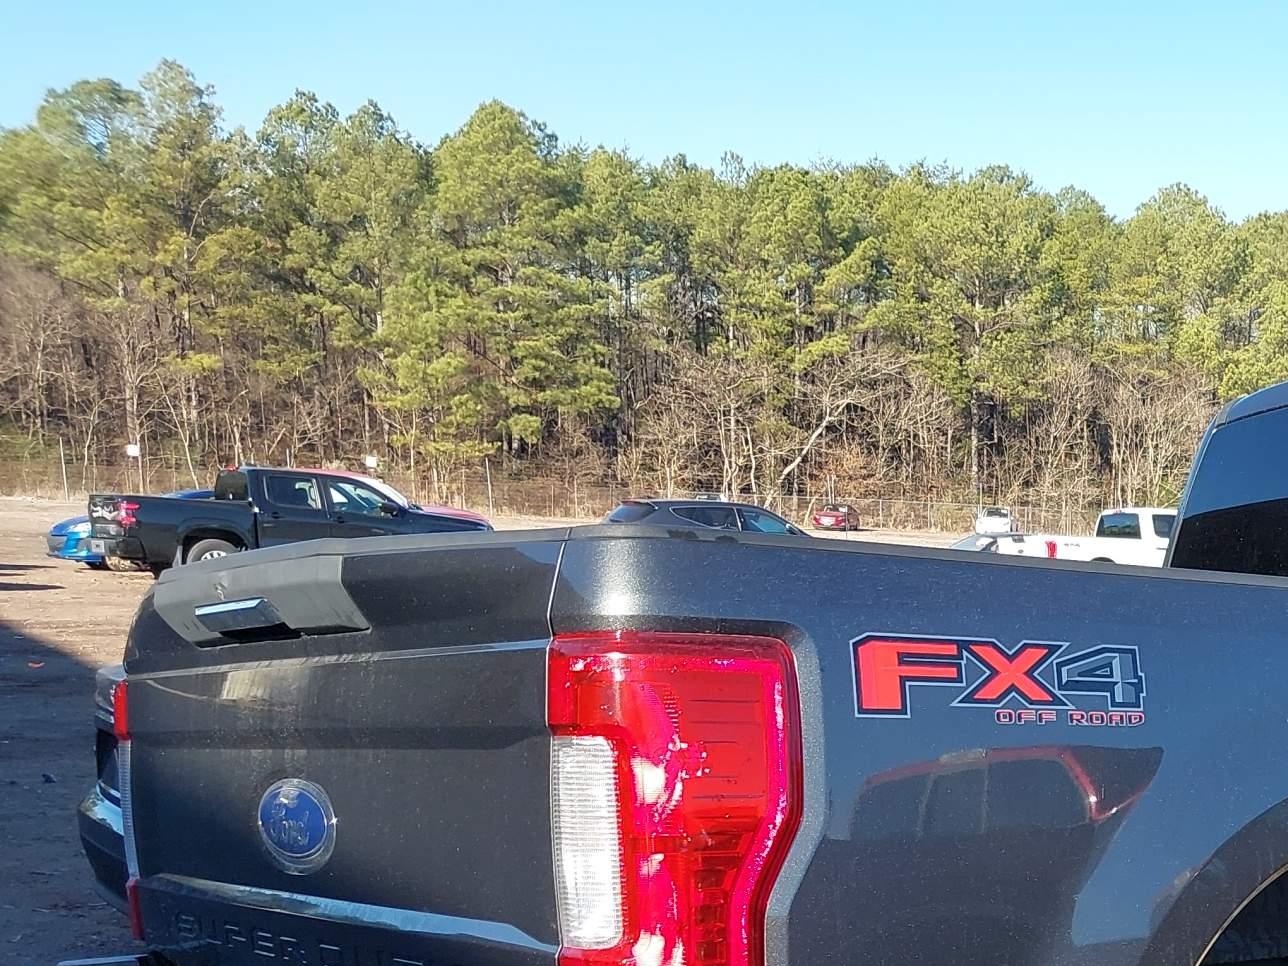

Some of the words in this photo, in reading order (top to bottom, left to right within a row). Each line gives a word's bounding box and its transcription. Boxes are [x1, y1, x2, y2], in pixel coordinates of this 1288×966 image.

[849, 632, 1146, 718] FX4
[994, 709, 1057, 725] OFF
[1068, 711, 1145, 727] ROAD
[175, 911, 308, 964] SUPER
